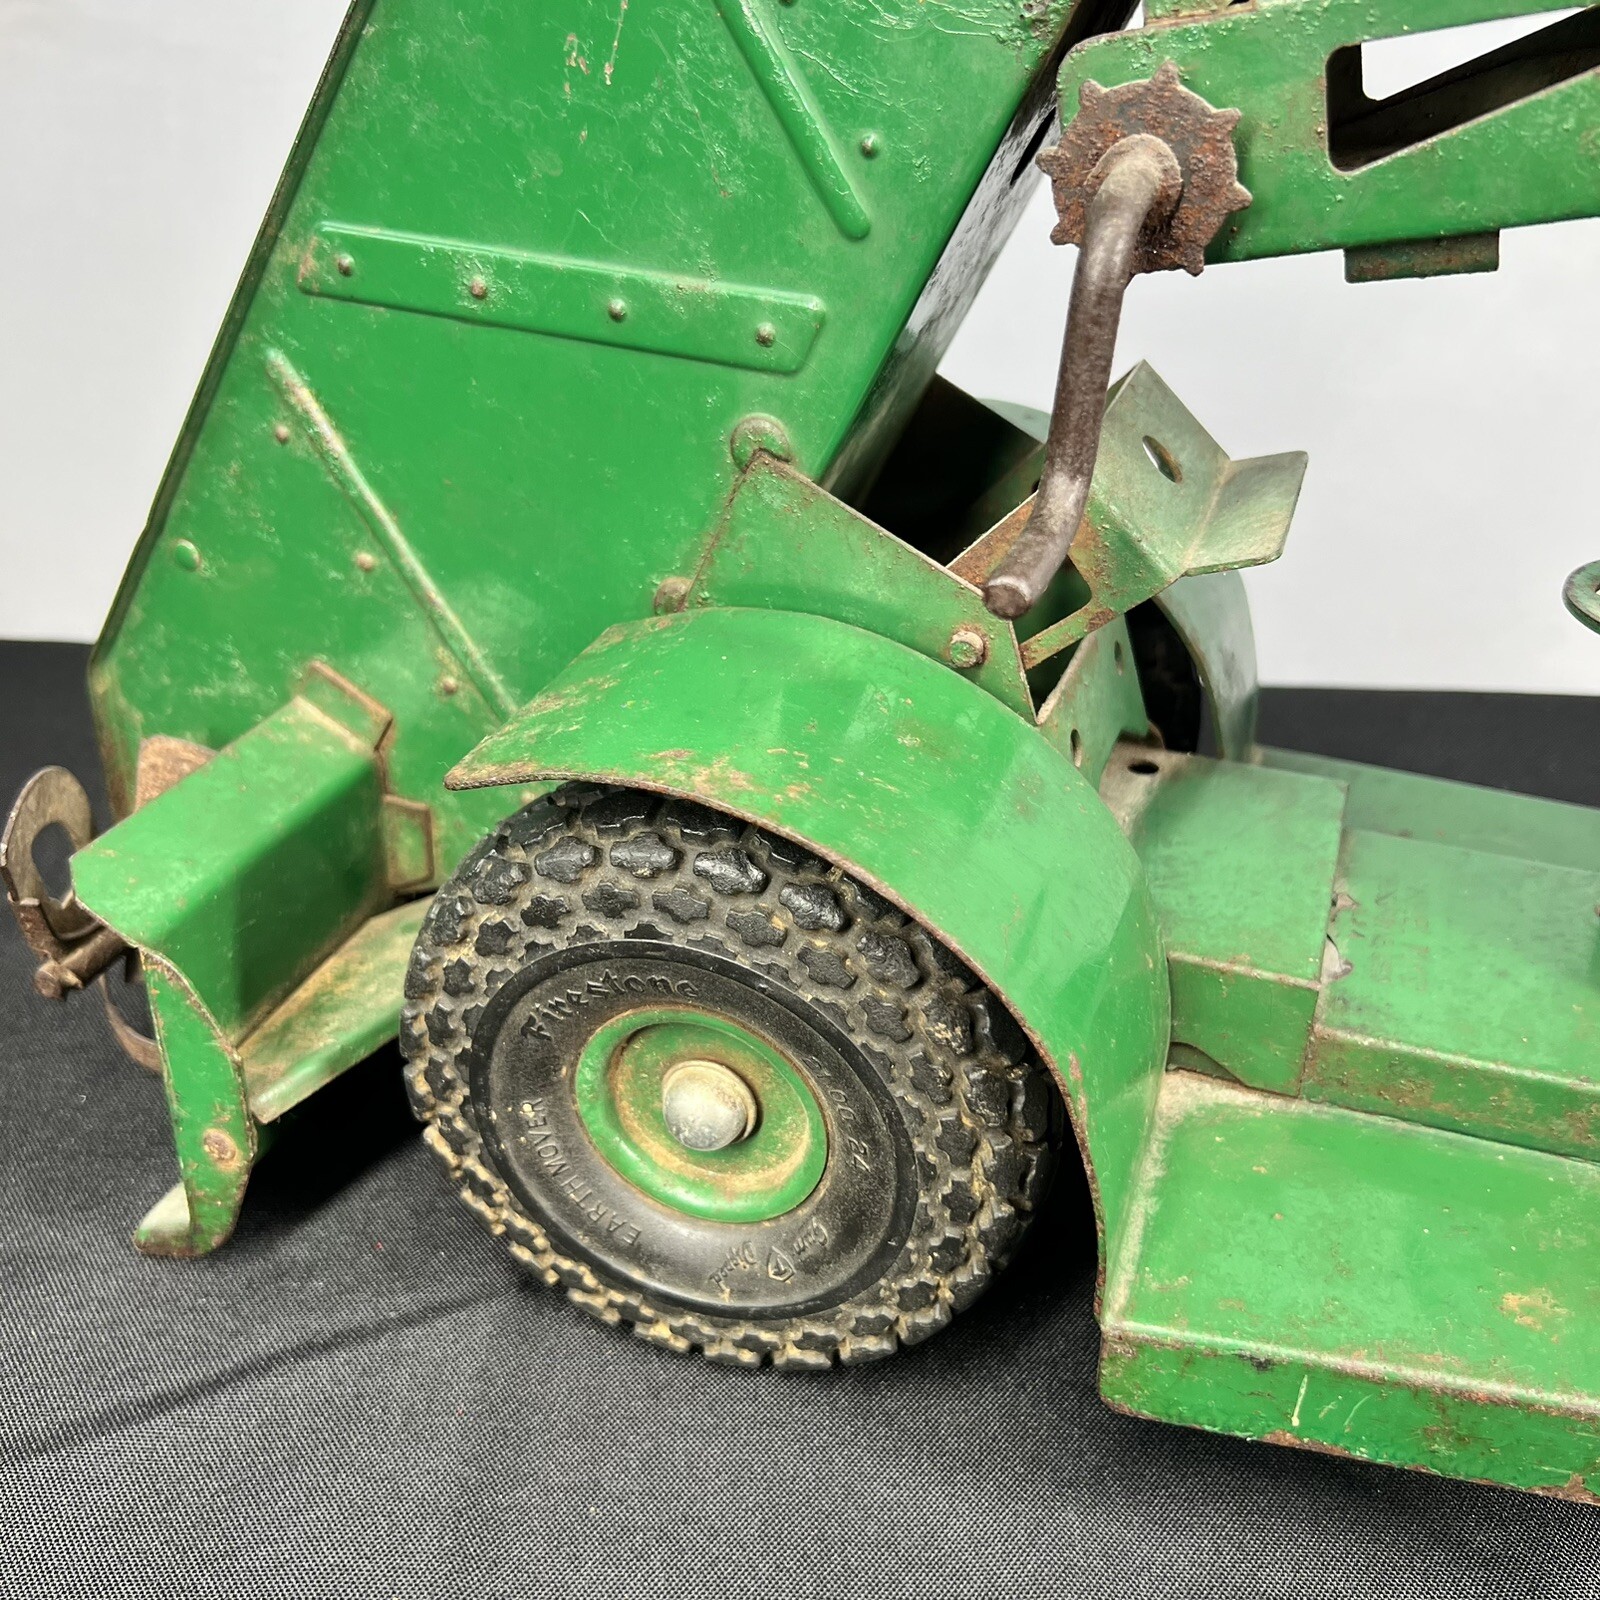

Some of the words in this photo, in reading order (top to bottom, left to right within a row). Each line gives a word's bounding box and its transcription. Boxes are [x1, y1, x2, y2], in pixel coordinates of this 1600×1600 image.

[520, 968, 702, 1041] Firestone
[519, 1097, 571, 1178] MOVER
[560, 1174, 642, 1246] EARTH
